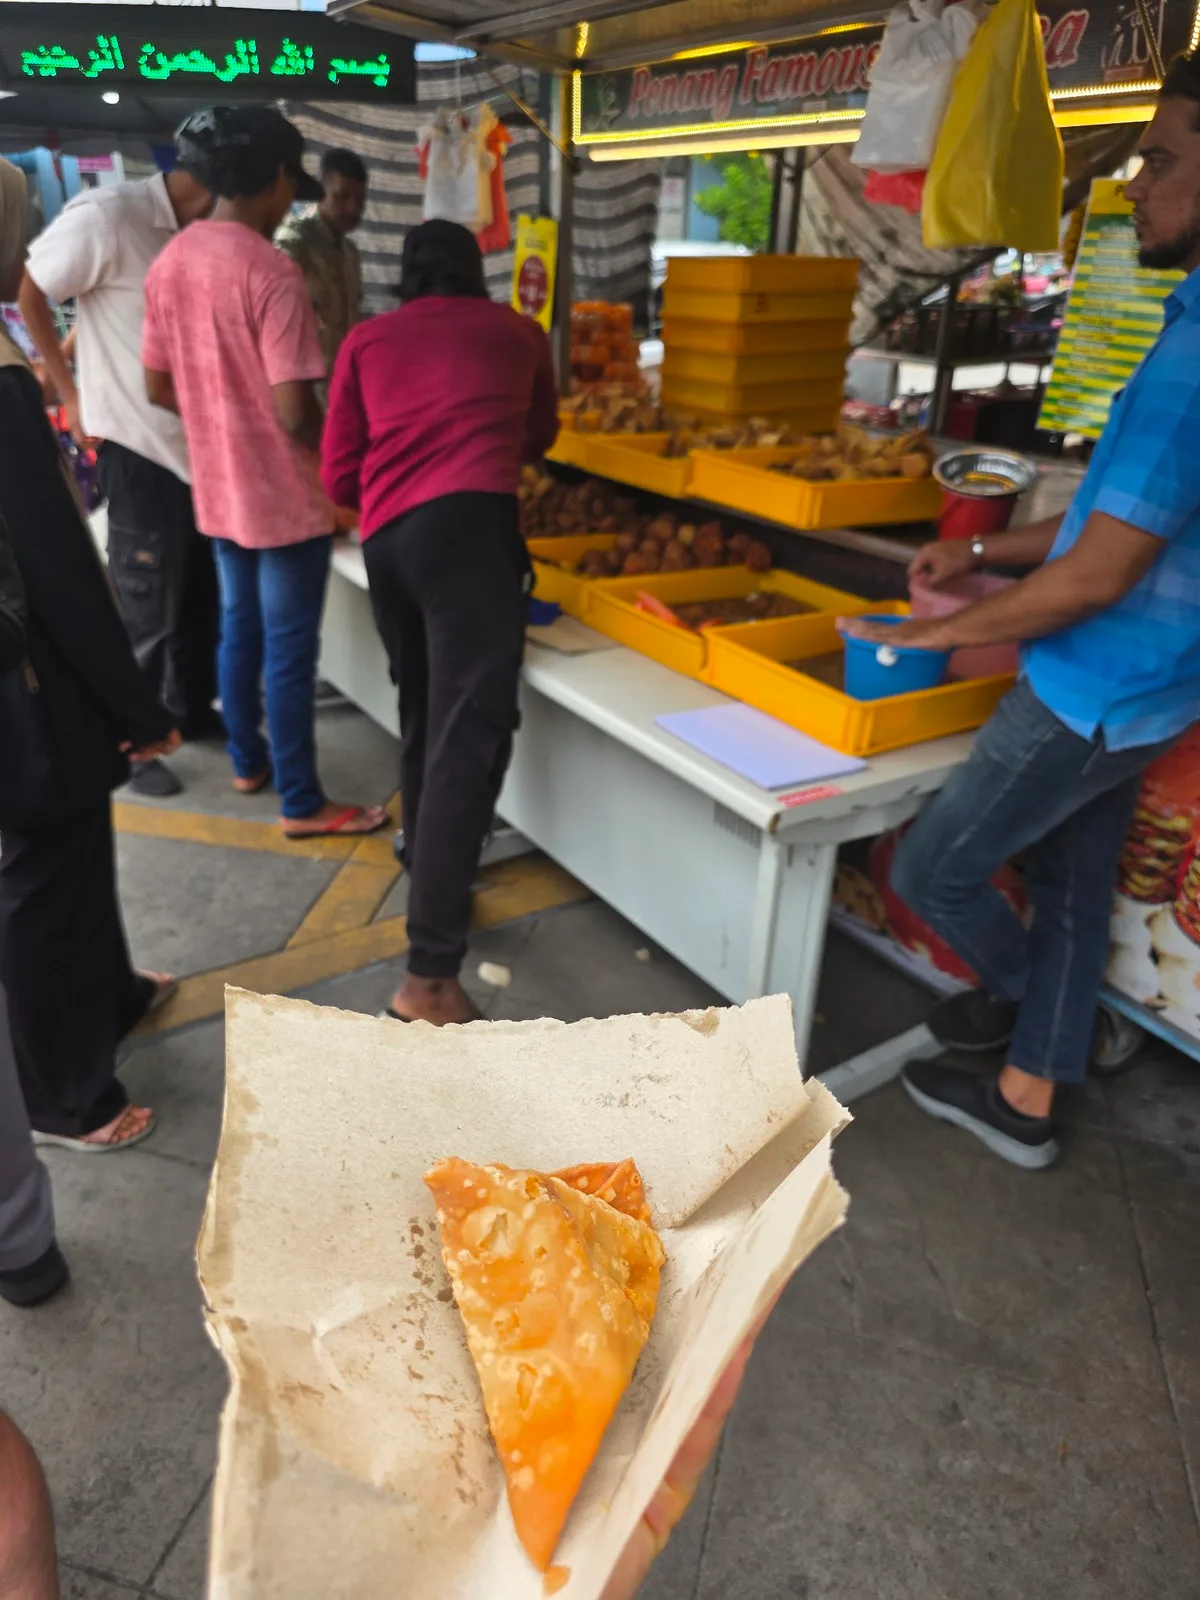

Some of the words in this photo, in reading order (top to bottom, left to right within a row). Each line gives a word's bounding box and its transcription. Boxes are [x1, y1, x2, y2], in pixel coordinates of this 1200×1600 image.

[271, 38, 314, 75] الله
[627, 65, 738, 120] Penang
[739, 42, 882, 105] Famous
